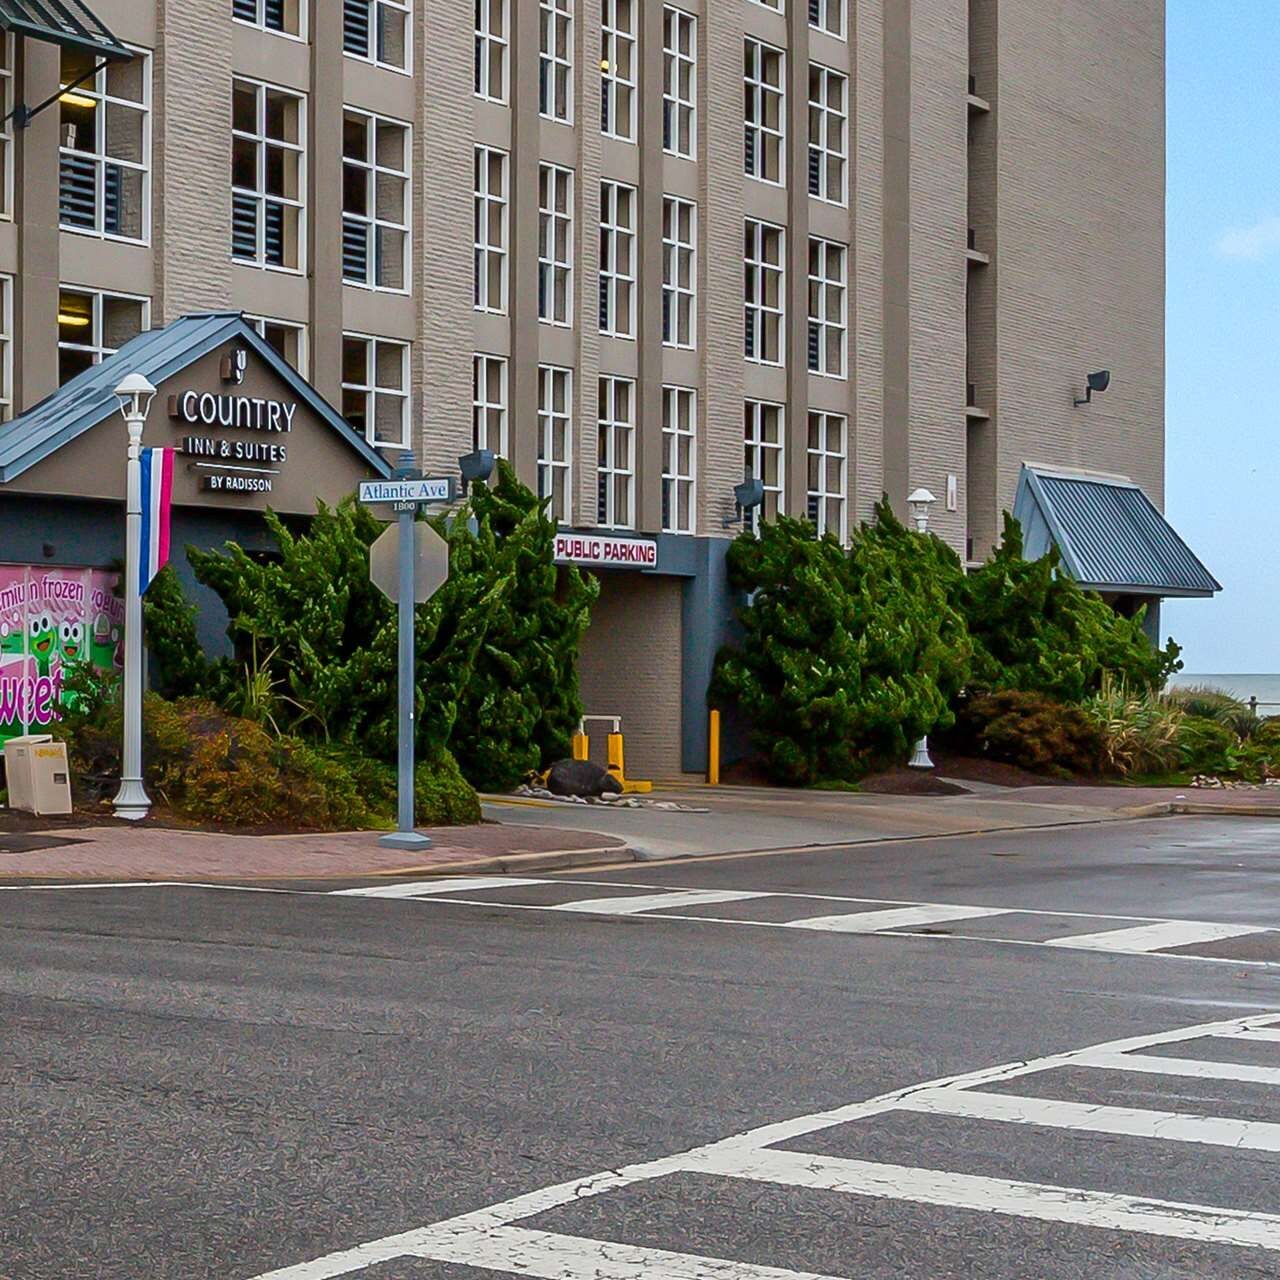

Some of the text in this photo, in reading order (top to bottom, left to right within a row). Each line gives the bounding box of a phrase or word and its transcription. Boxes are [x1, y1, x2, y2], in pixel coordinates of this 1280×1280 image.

[183, 390, 297, 433] COUNTRY
[188, 437, 287, 462] INN & SUITES
[211, 477, 272, 492] BY RADISSON
[363, 483, 446, 499] Atlantic Ave
[393, 502, 416, 511] 1800
[557, 539, 655, 563] PUBLIC PARKING
[43, 576, 83, 601] frozen
